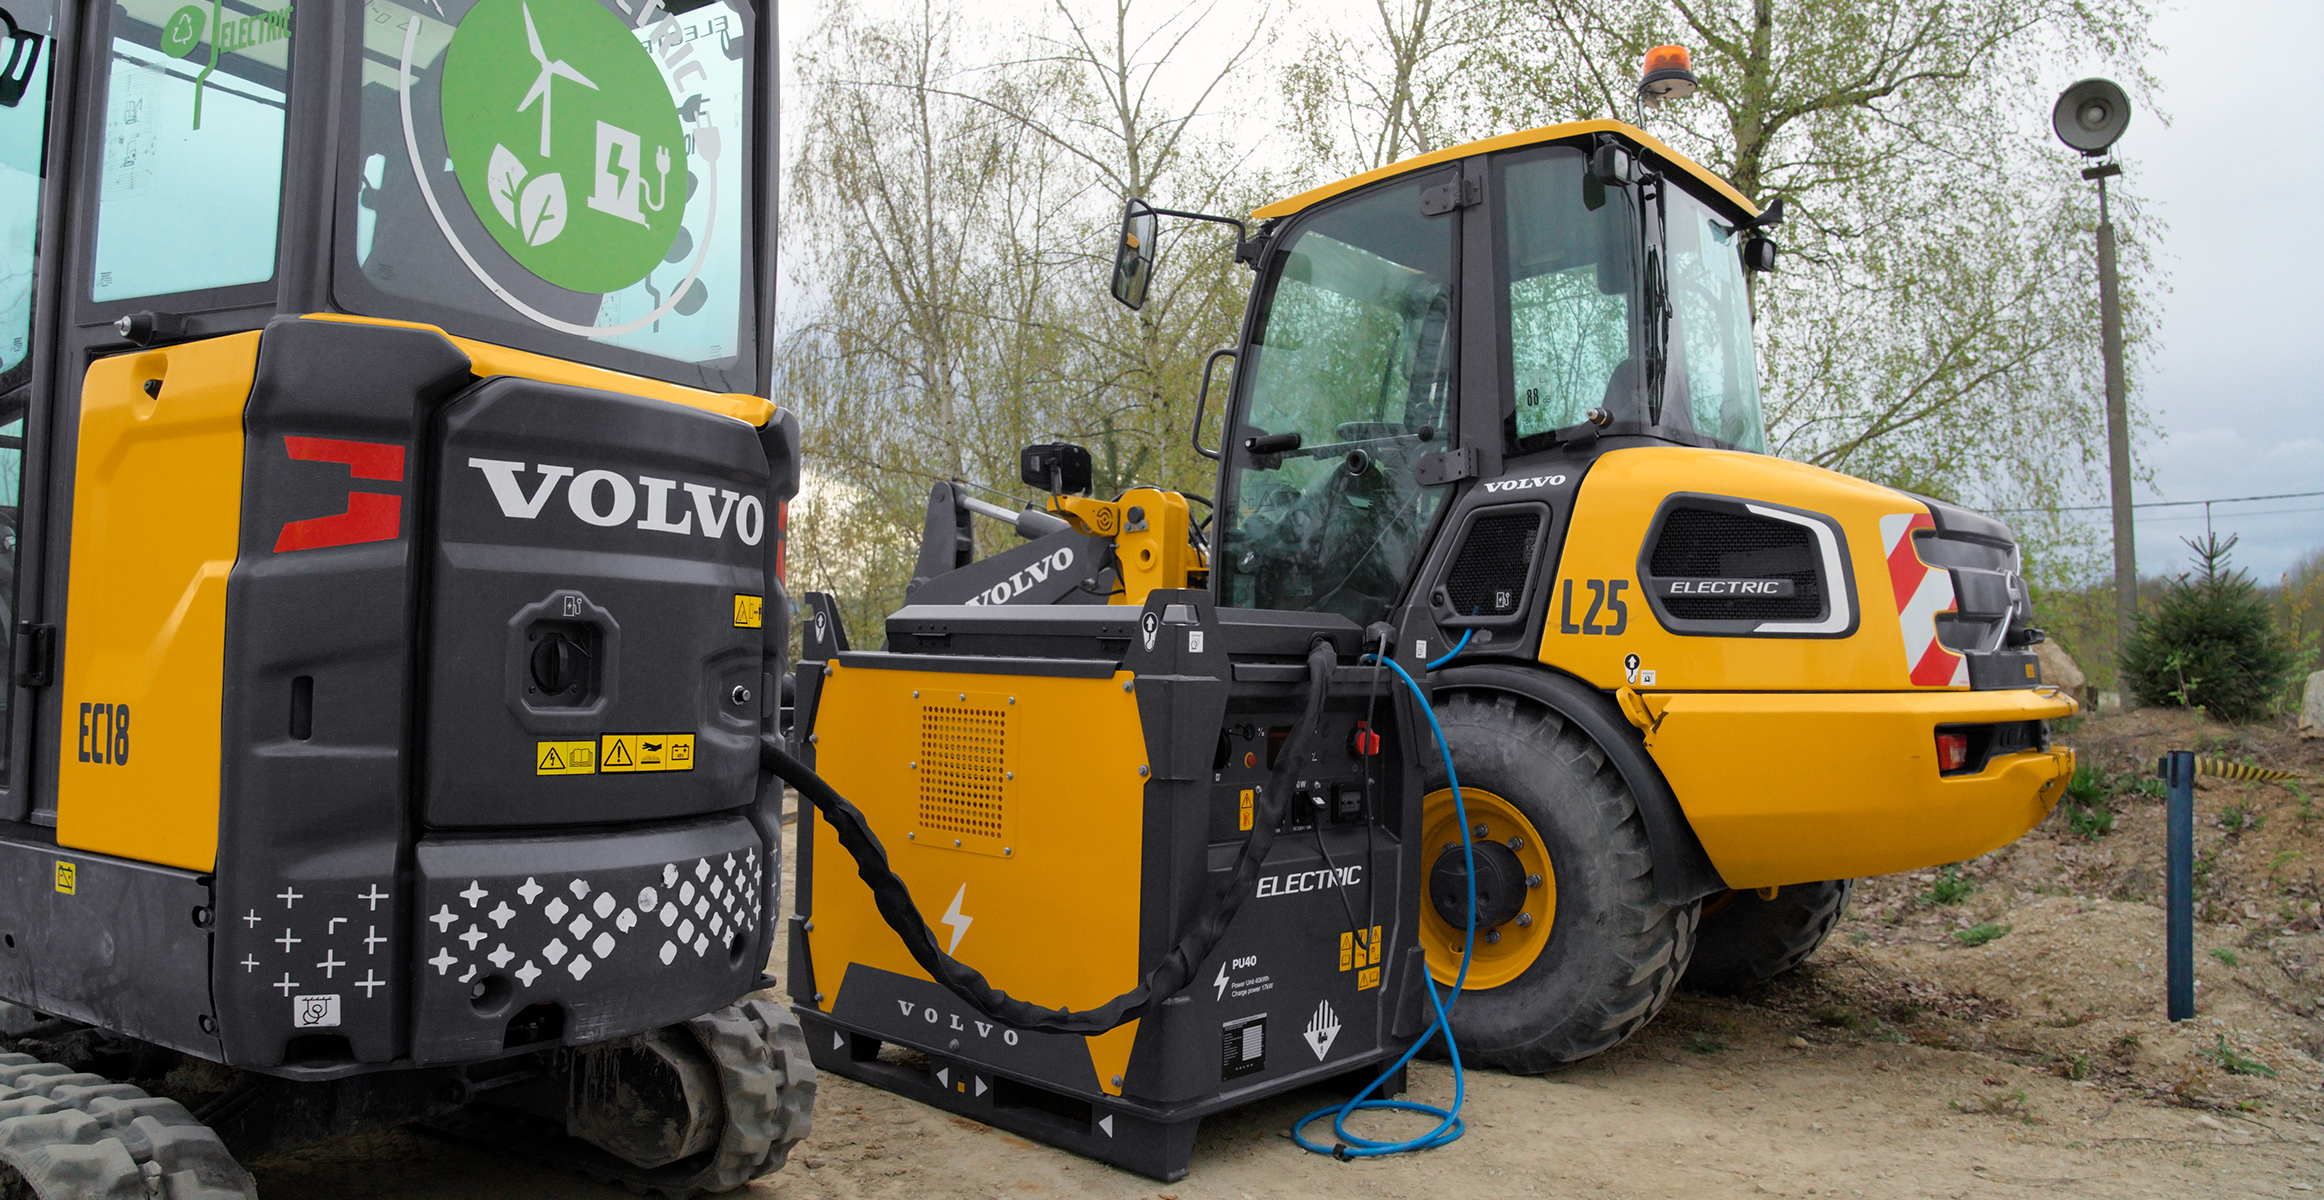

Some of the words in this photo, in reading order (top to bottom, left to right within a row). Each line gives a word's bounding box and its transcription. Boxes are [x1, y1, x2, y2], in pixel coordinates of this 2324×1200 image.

[219, 5, 294, 54] ELECTRIC
[1526, 387, 1540, 407] 88
[1483, 474, 1567, 493] VOLVO
[468, 457, 764, 546] VOLVO
[1670, 581, 1780, 594] ELECTRIC
[1560, 578, 1629, 636] L25
[78, 702, 130, 767] EC18
[1256, 865, 1362, 898] ELECTRIC
[1232, 954, 1257, 970] PU40
[1231, 981, 1245, 989] Power
[1245, 978, 1255, 986] Unit
[1231, 990, 1248, 998] Charge
[1248, 986, 1261, 995] power
[897, 999, 1019, 1046] VOLVO
